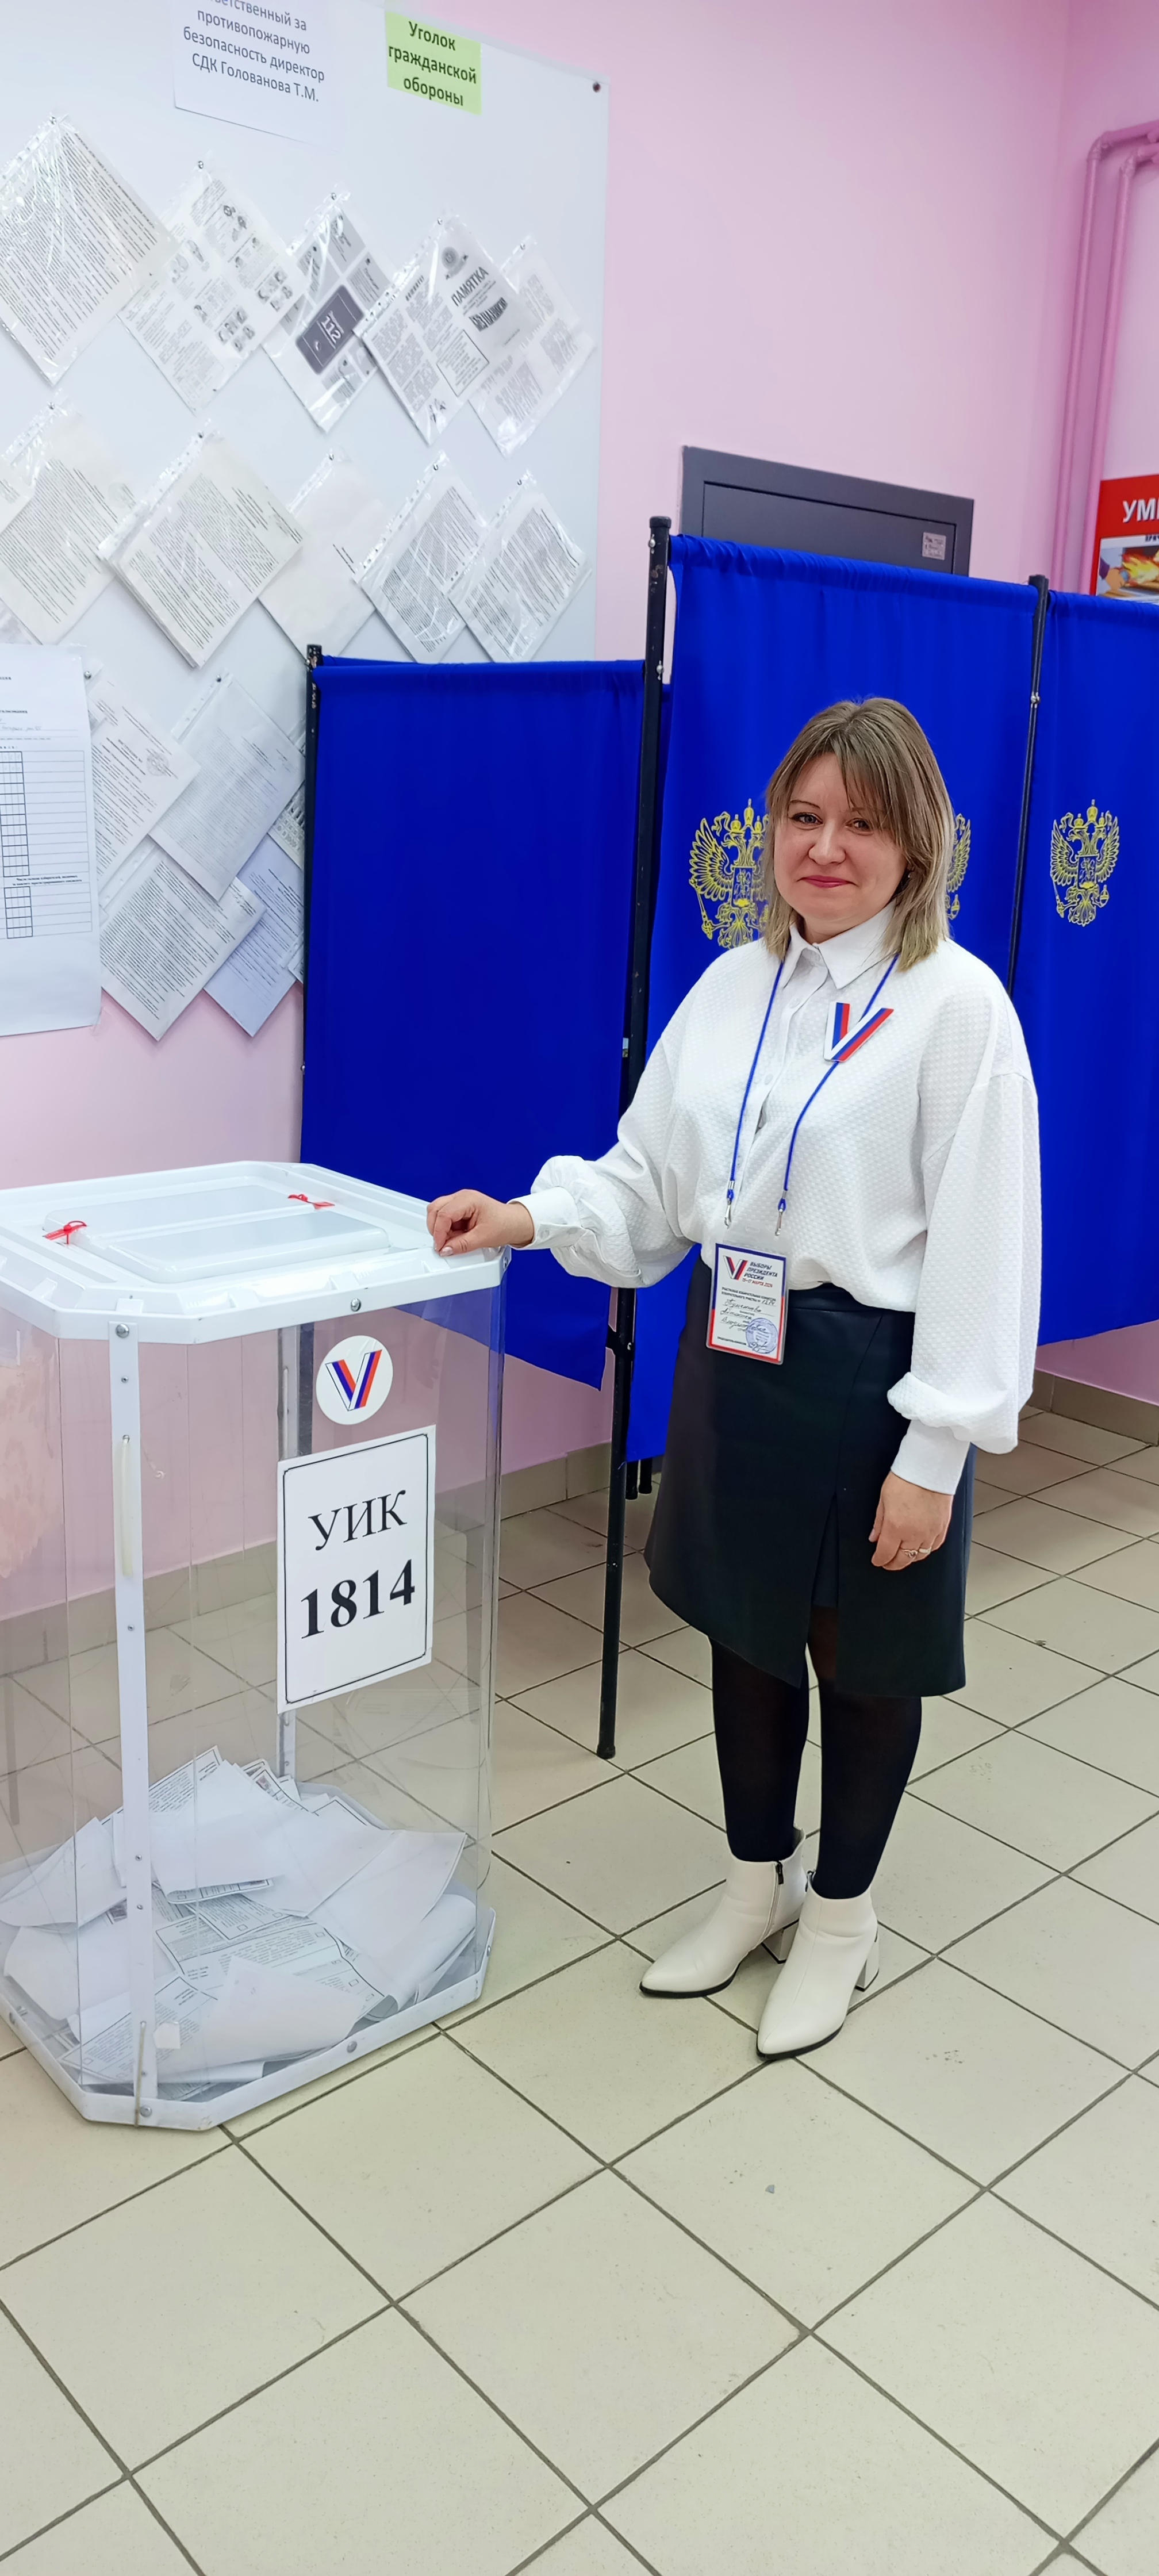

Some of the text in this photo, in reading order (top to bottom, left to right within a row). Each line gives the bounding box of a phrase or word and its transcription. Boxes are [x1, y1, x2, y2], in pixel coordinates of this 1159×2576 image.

[198, 10, 310, 54] противопожарную
[294, 18, 306, 30] за
[409, 21, 456, 51] Уголок
[183, 26, 324, 83] безопасность директор
[389, 45, 477, 84] гражданской
[193, 53, 318, 102] СДК Голованова Т.М.
[404, 76, 463, 106] обороны
[451, 266, 489, 306] ПАМЯТКА
[320, 316, 342, 344] 112
[1123, 497, 1159, 523] УМ
[744, 1272, 764, 1281] РОССИИ
[746, 1267, 778, 1277] ПРЕЗИДЕНТА
[750, 1262, 772, 1270] ВЫБОРЫ
[308, 1490, 407, 1551] УИК
[301, 1559, 415, 1639] 1814
